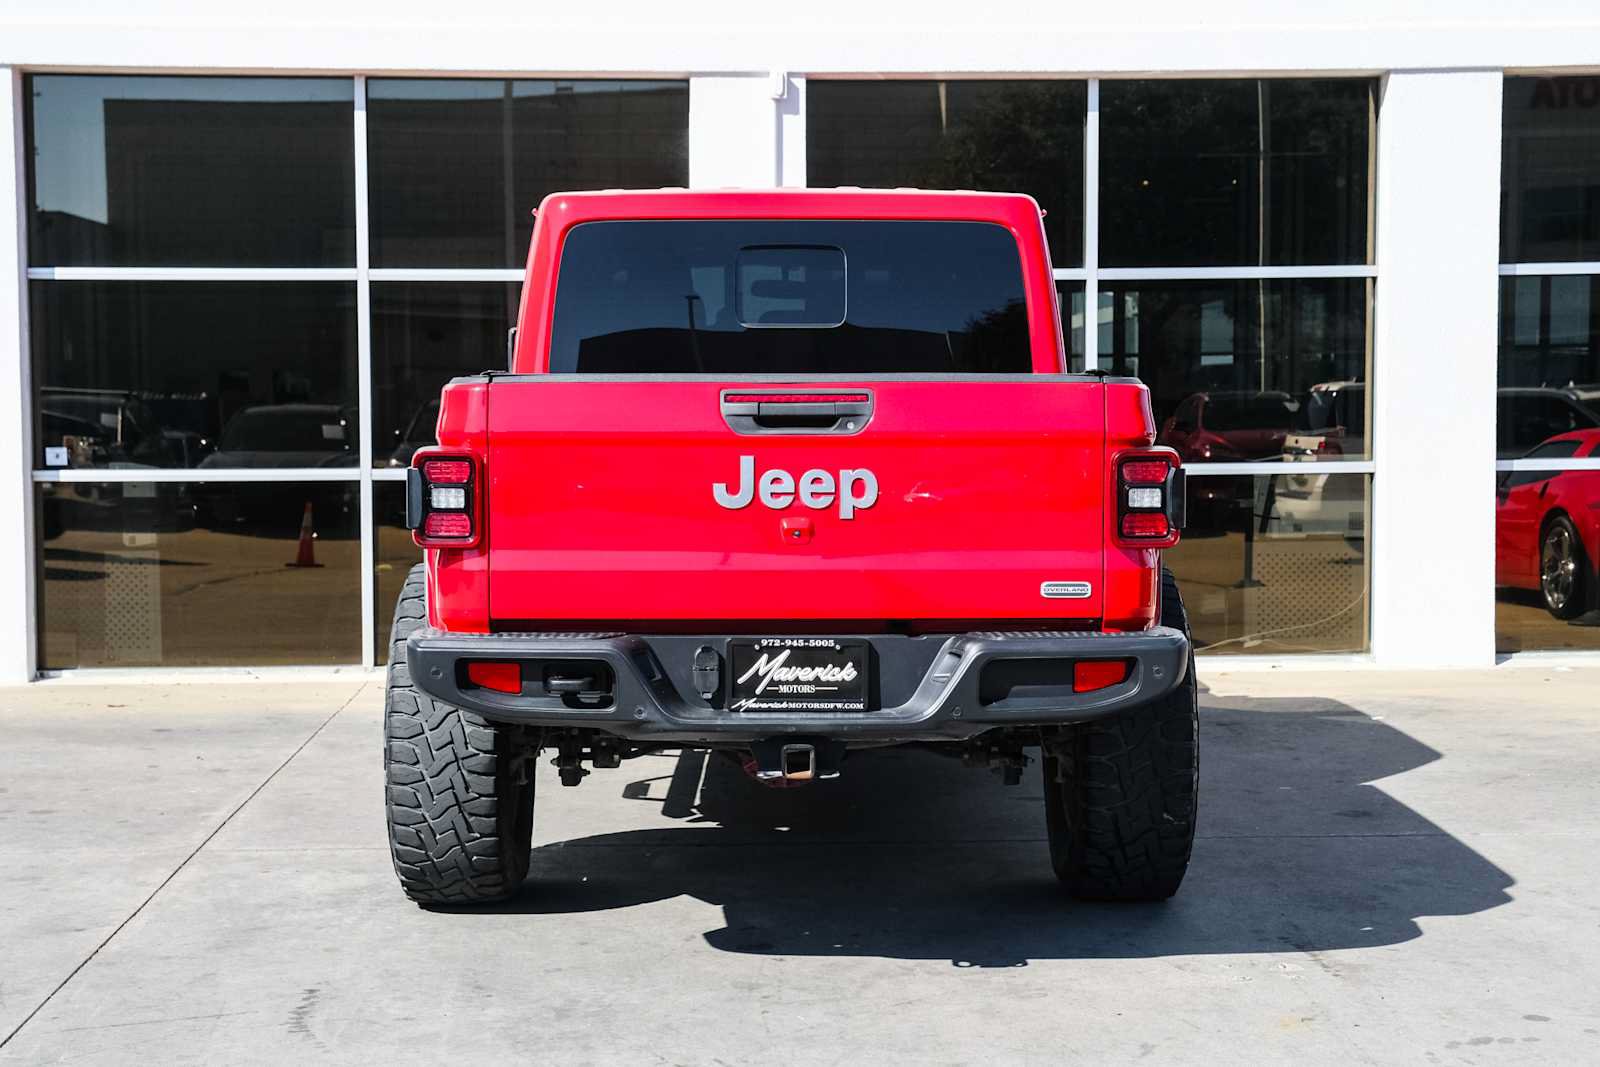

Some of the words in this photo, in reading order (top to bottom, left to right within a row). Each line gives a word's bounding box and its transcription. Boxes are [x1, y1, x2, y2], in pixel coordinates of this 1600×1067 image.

[712, 455, 879, 520] Jeep
[761, 639, 835, 647] 972-945-5005
[737, 649, 858, 695] Maverick
[778, 684, 816, 694] MOTORS
